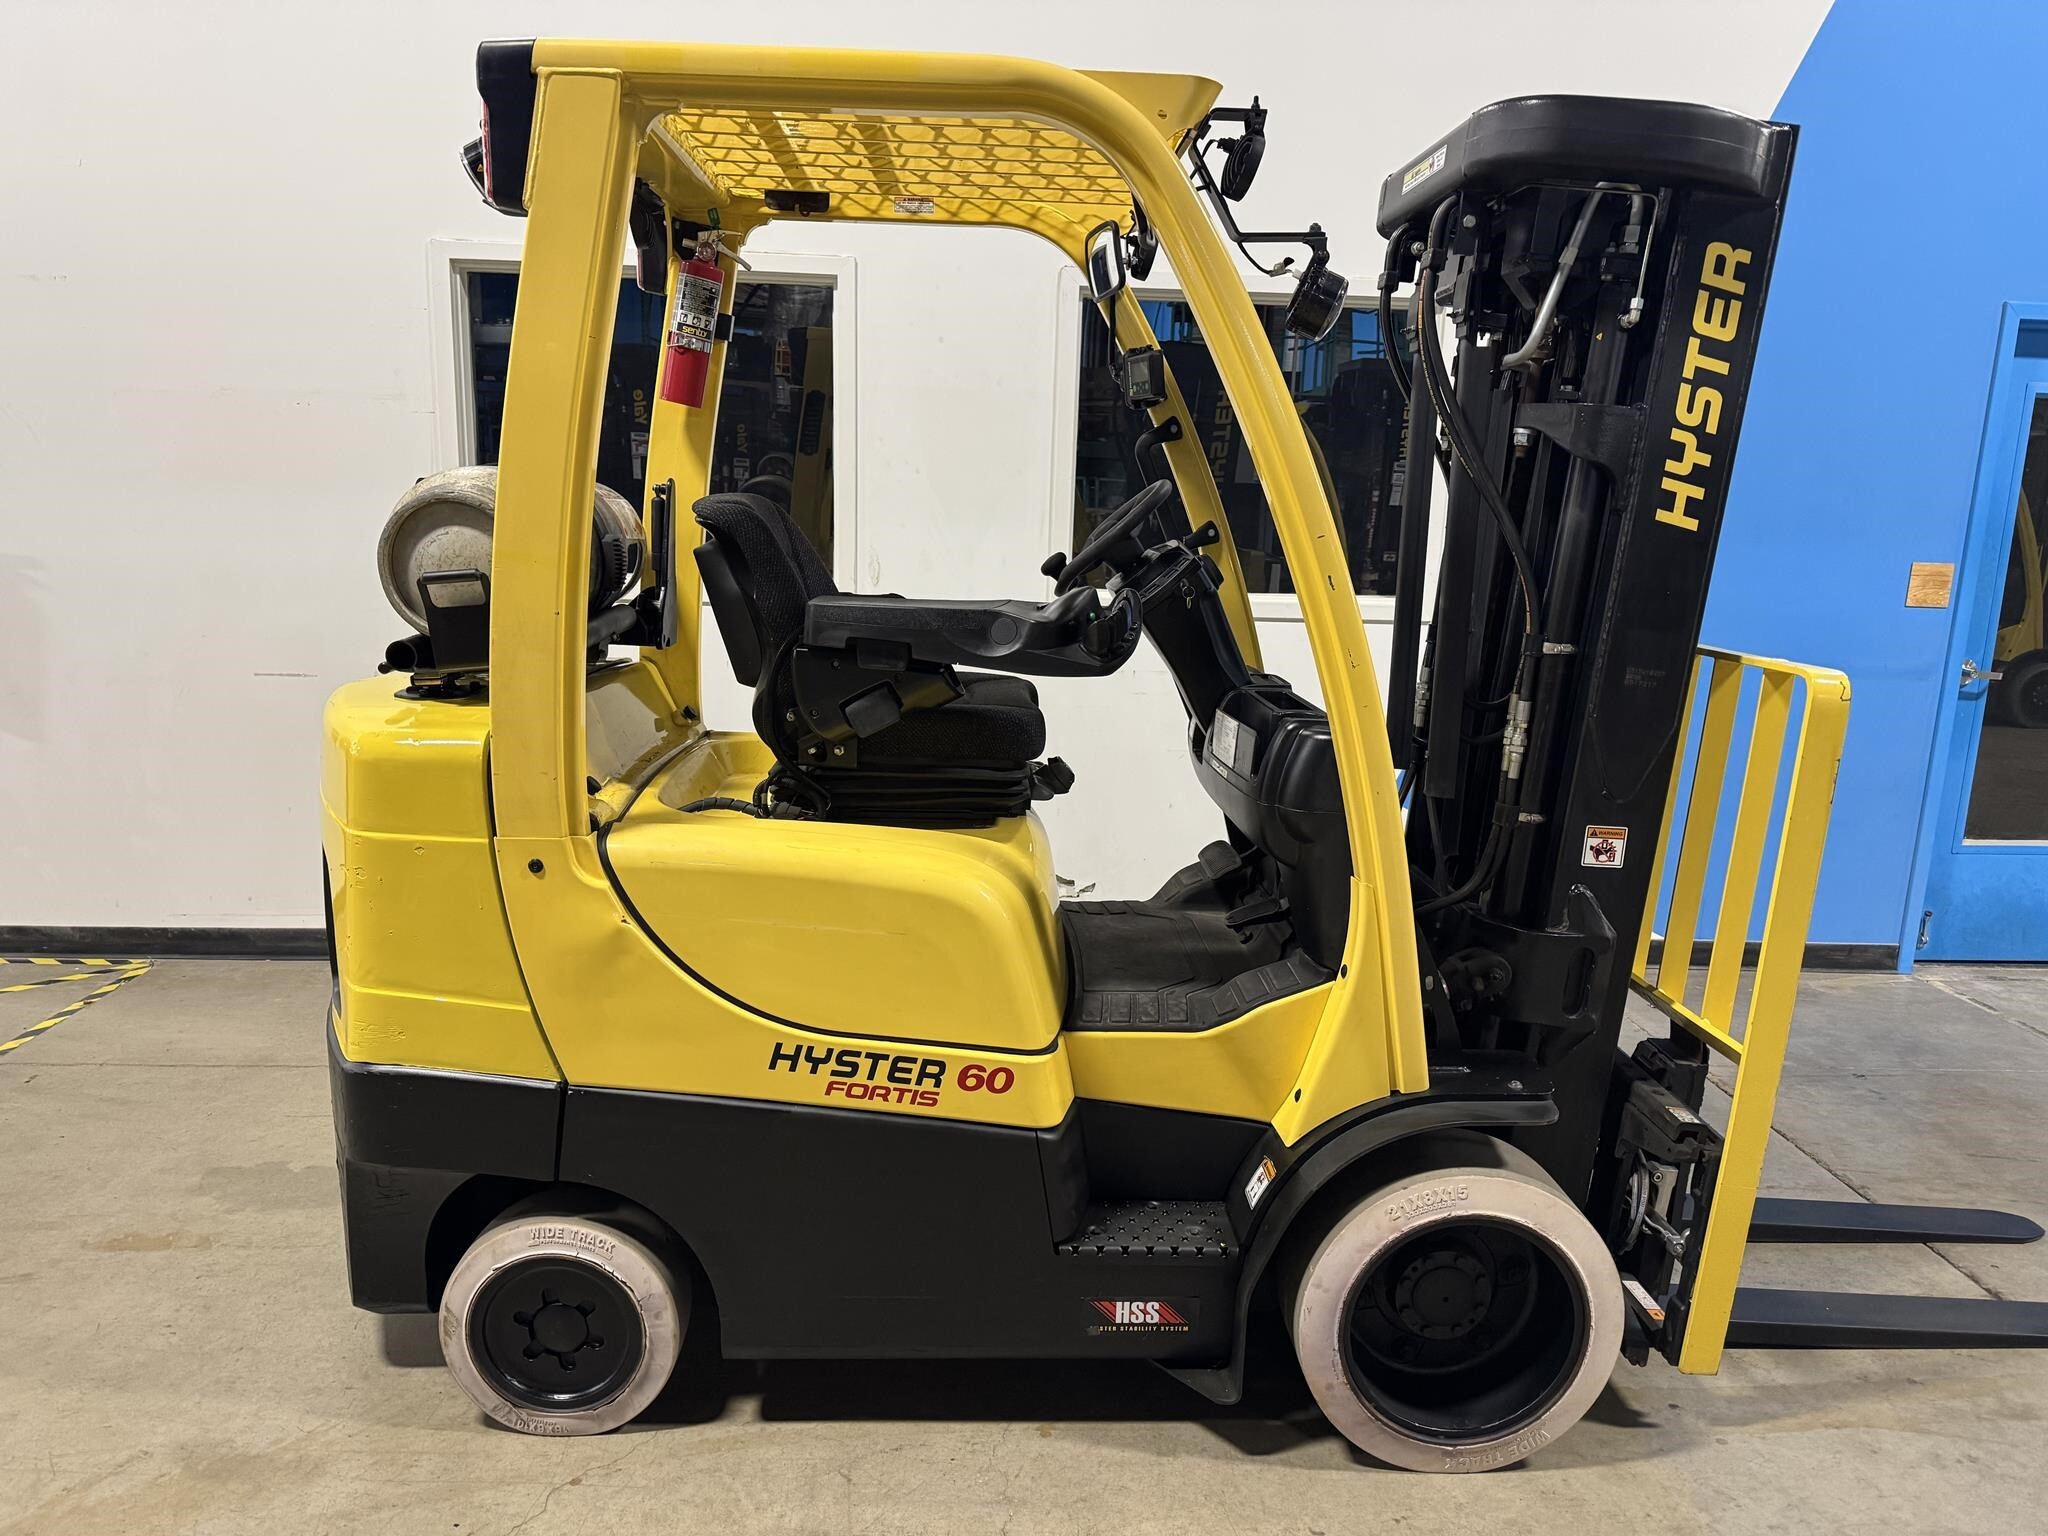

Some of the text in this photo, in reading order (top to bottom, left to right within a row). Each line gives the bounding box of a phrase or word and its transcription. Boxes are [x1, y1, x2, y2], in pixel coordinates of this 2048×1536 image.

[682, 325, 708, 338] sentry
[1656, 242, 1750, 531] HYSTER
[768, 1042, 1015, 1095] HYSTER 60
[824, 1080, 941, 1107] FORTIS
[1384, 1184, 1470, 1221] 21X8X15
[529, 1226, 617, 1255] WIDE TRACK
[1115, 1301, 1160, 1324] HSS
